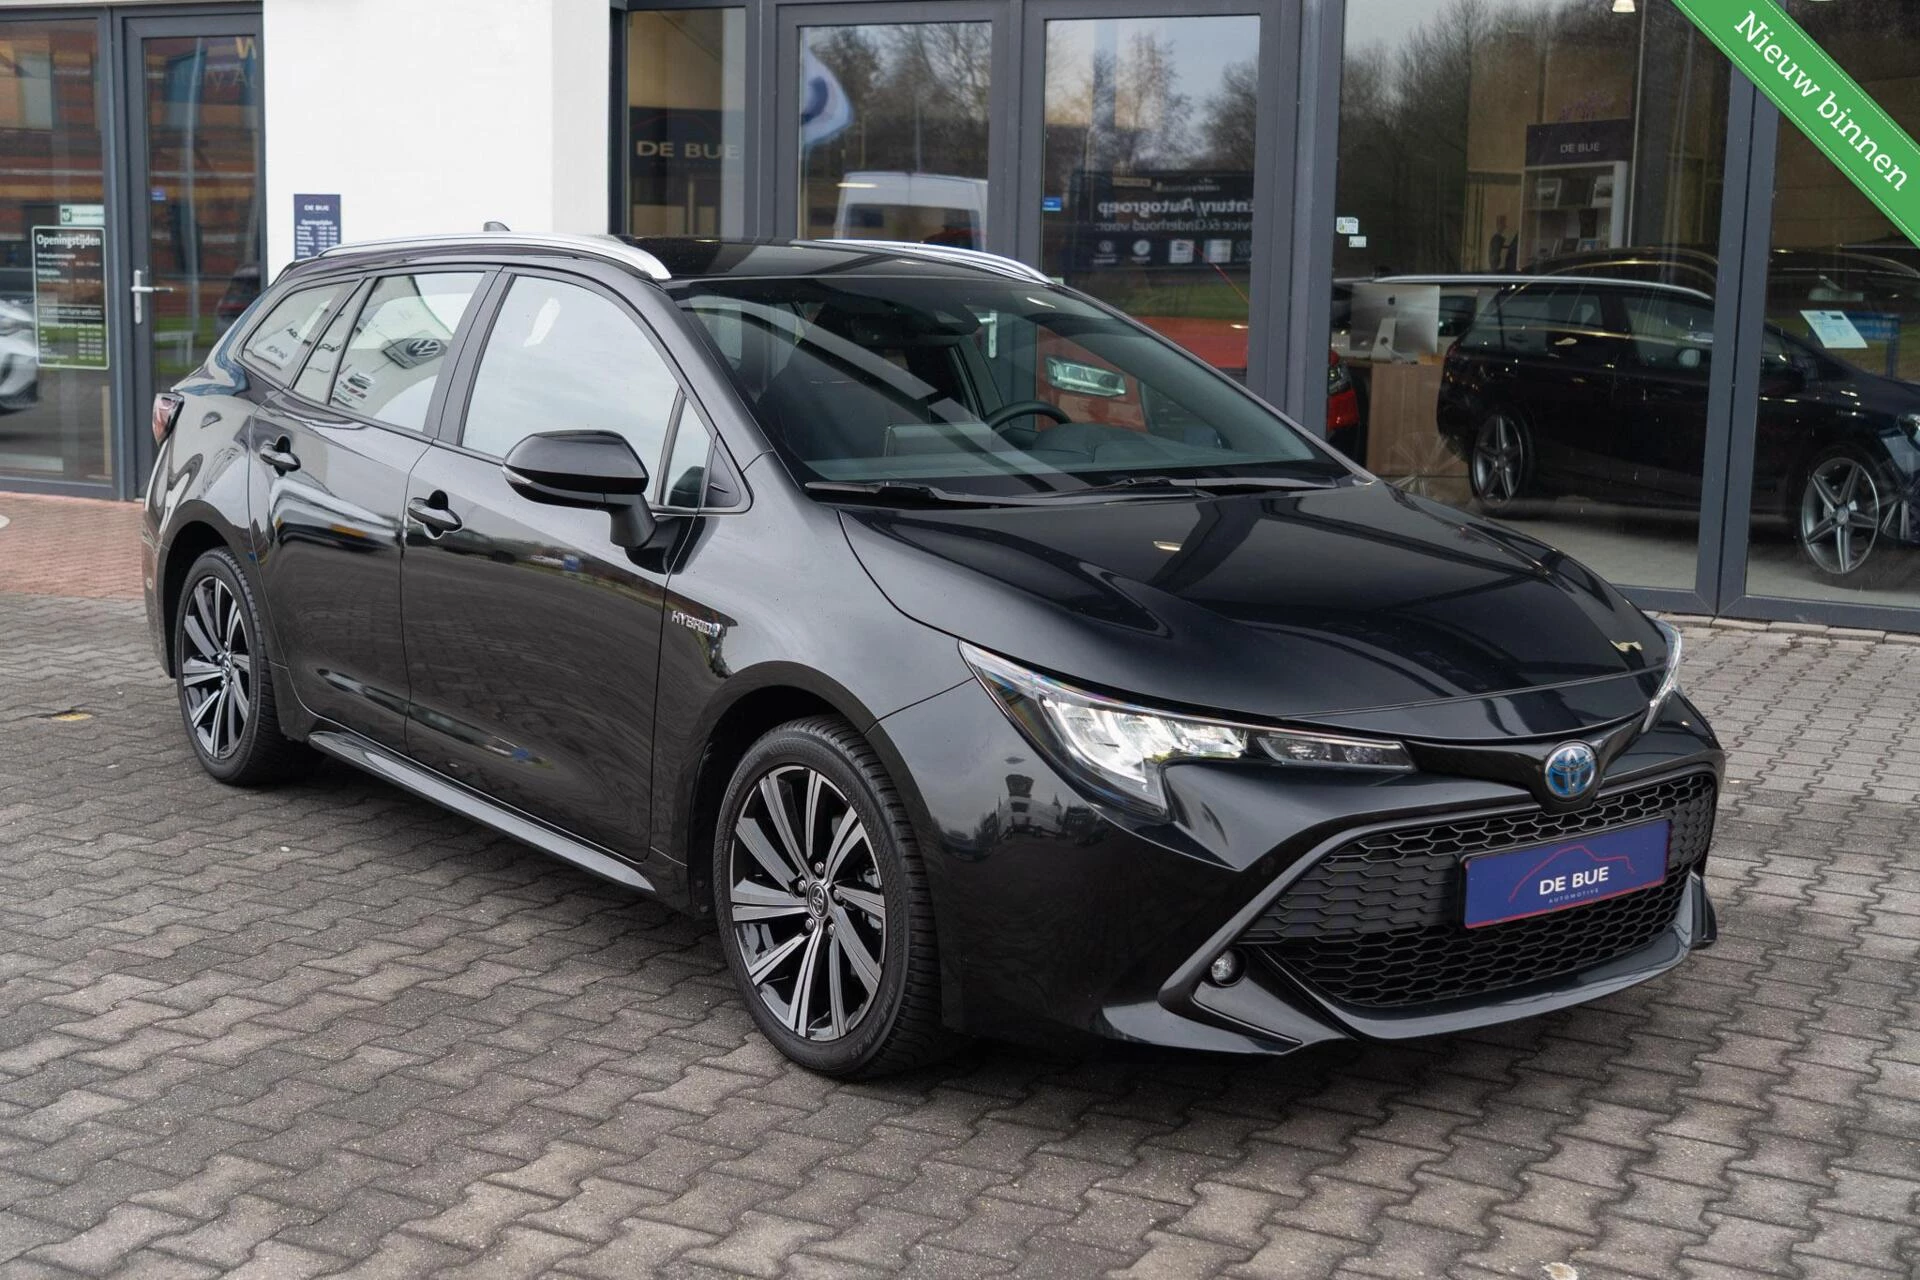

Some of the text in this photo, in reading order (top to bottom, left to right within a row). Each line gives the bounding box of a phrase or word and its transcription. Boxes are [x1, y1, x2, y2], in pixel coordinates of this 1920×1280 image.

[636, 141, 740, 160] DE BUE
[1560, 143, 1577, 153] DE
[36, 233, 101, 249] Openingstijden
[671, 610, 712, 635] HYBRID
[1539, 866, 1609, 896] DE BUE
[1548, 888, 1599, 904] AUTOMOTIVE
